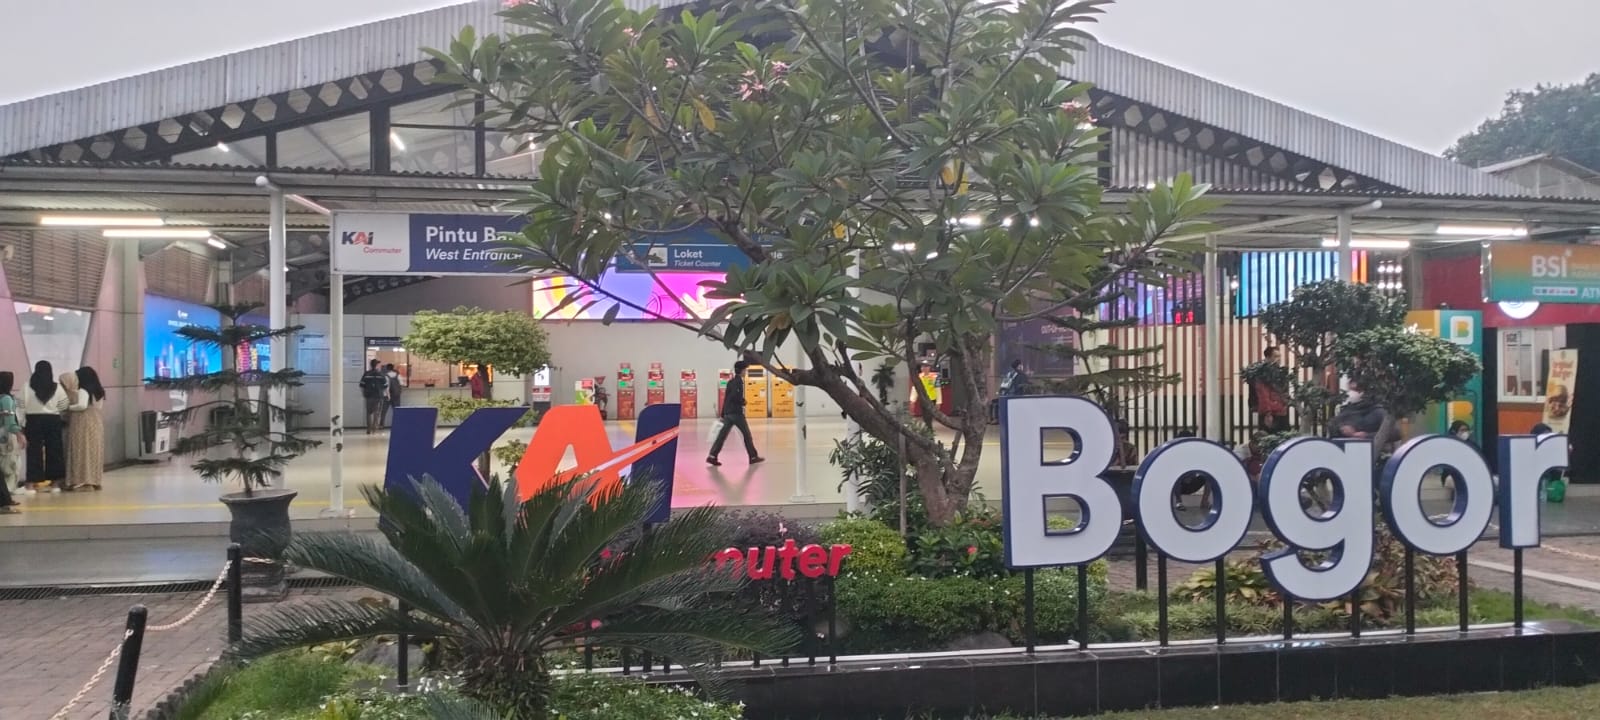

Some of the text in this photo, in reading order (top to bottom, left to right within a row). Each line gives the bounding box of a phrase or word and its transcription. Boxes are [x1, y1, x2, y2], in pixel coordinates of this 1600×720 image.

[425, 226, 478, 243] Pintu
[426, 248, 460, 261] West
[674, 249, 703, 259] Loket
[674, 259, 722, 267] Ticket Counter
[1000, 395, 1569, 600] Bogor
